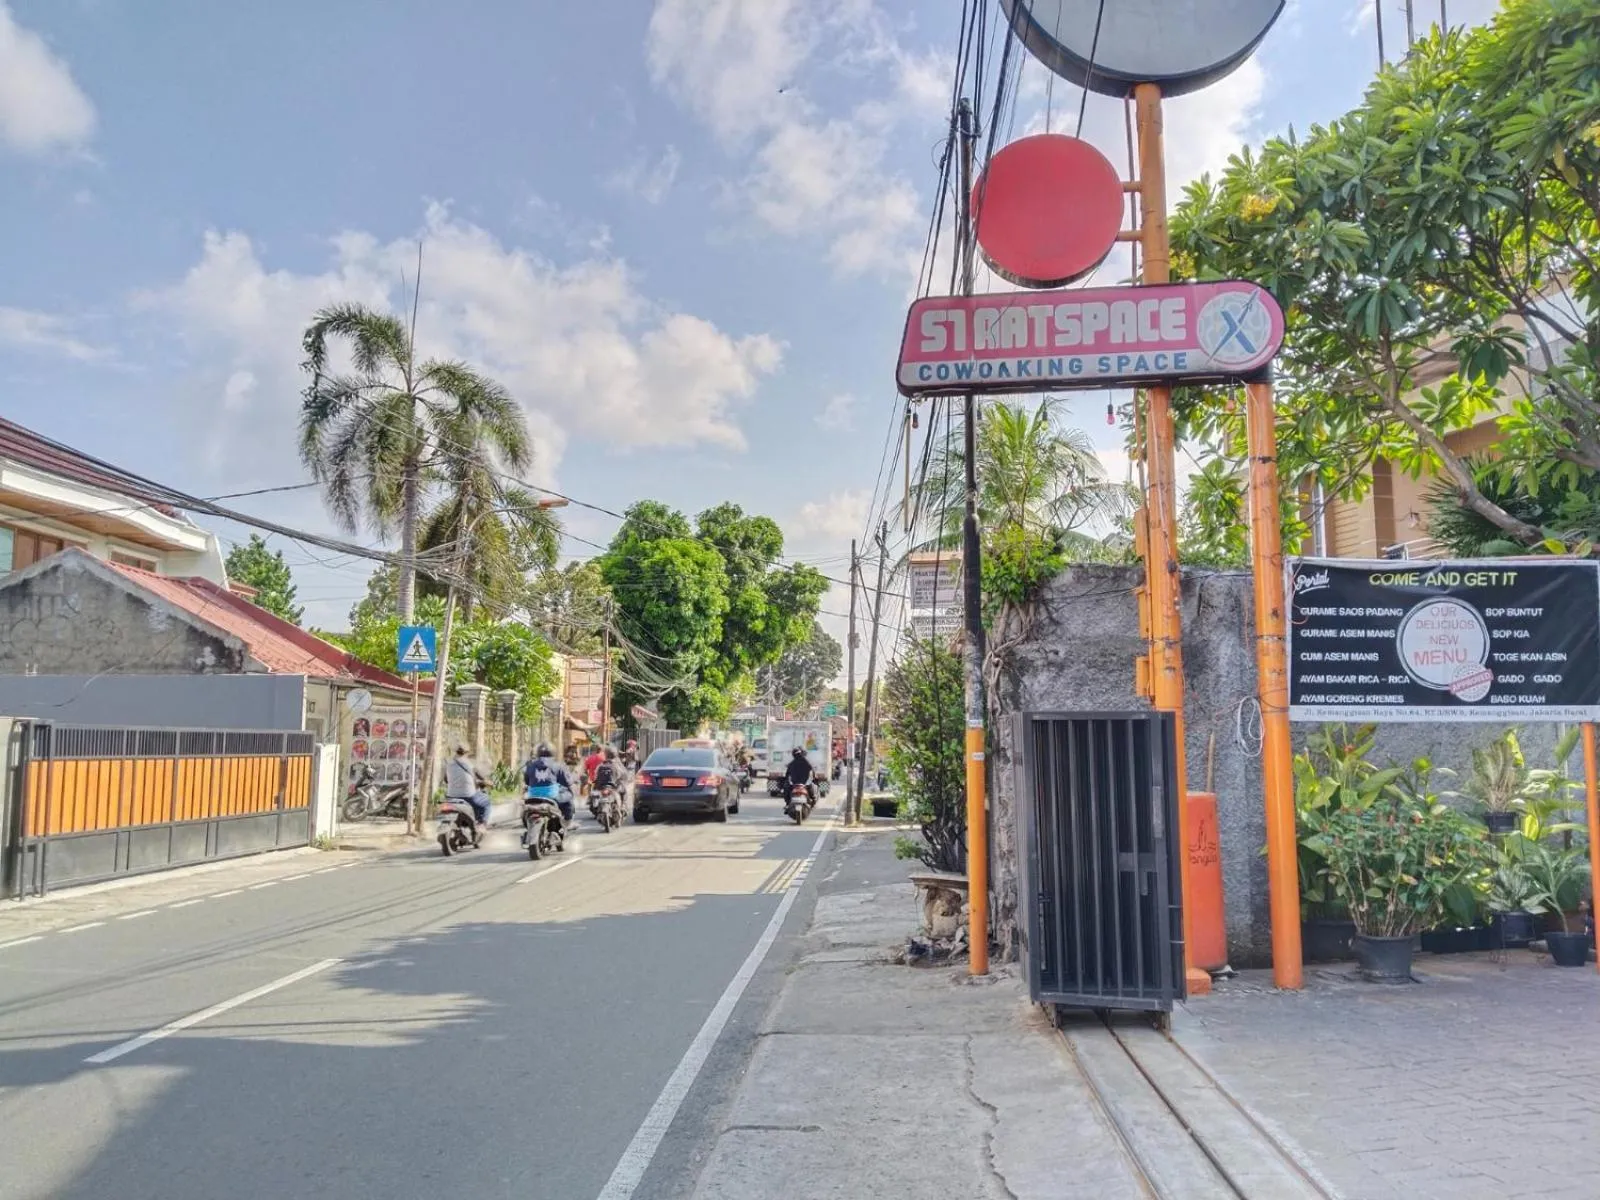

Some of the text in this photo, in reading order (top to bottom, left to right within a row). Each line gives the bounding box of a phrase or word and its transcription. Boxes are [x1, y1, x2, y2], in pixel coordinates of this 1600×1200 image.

[1098, 352, 1188, 374] SPACE
[1368, 571, 1519, 587] COME AND GET IT
[1300, 607, 1404, 616] GURAME SAOS PADANG
[1430, 606, 1458, 617] OUR
[1485, 607, 1544, 617] SOP BUNTUT
[1300, 628, 1396, 638] GURAME ASEM MANIS
[1492, 629, 1512, 639] SOP
[1429, 634, 1460, 645] NEW
[1300, 652, 1380, 661] CUMI ASEM MANIS
[1413, 648, 1468, 667] MENU
[1492, 652, 1568, 662] TOGE IKAN ASIN
[1300, 674, 1325, 683] AYAM
[1326, 674, 1357, 683] BAKAR
[1358, 674, 1380, 683] RICA
[1388, 674, 1410, 683] RICA
[1497, 674, 1563, 684] GADO GADO
[1300, 694, 1405, 703] AYAM GORENG KREMES
[1490, 694, 1546, 704] BASO KUAH
